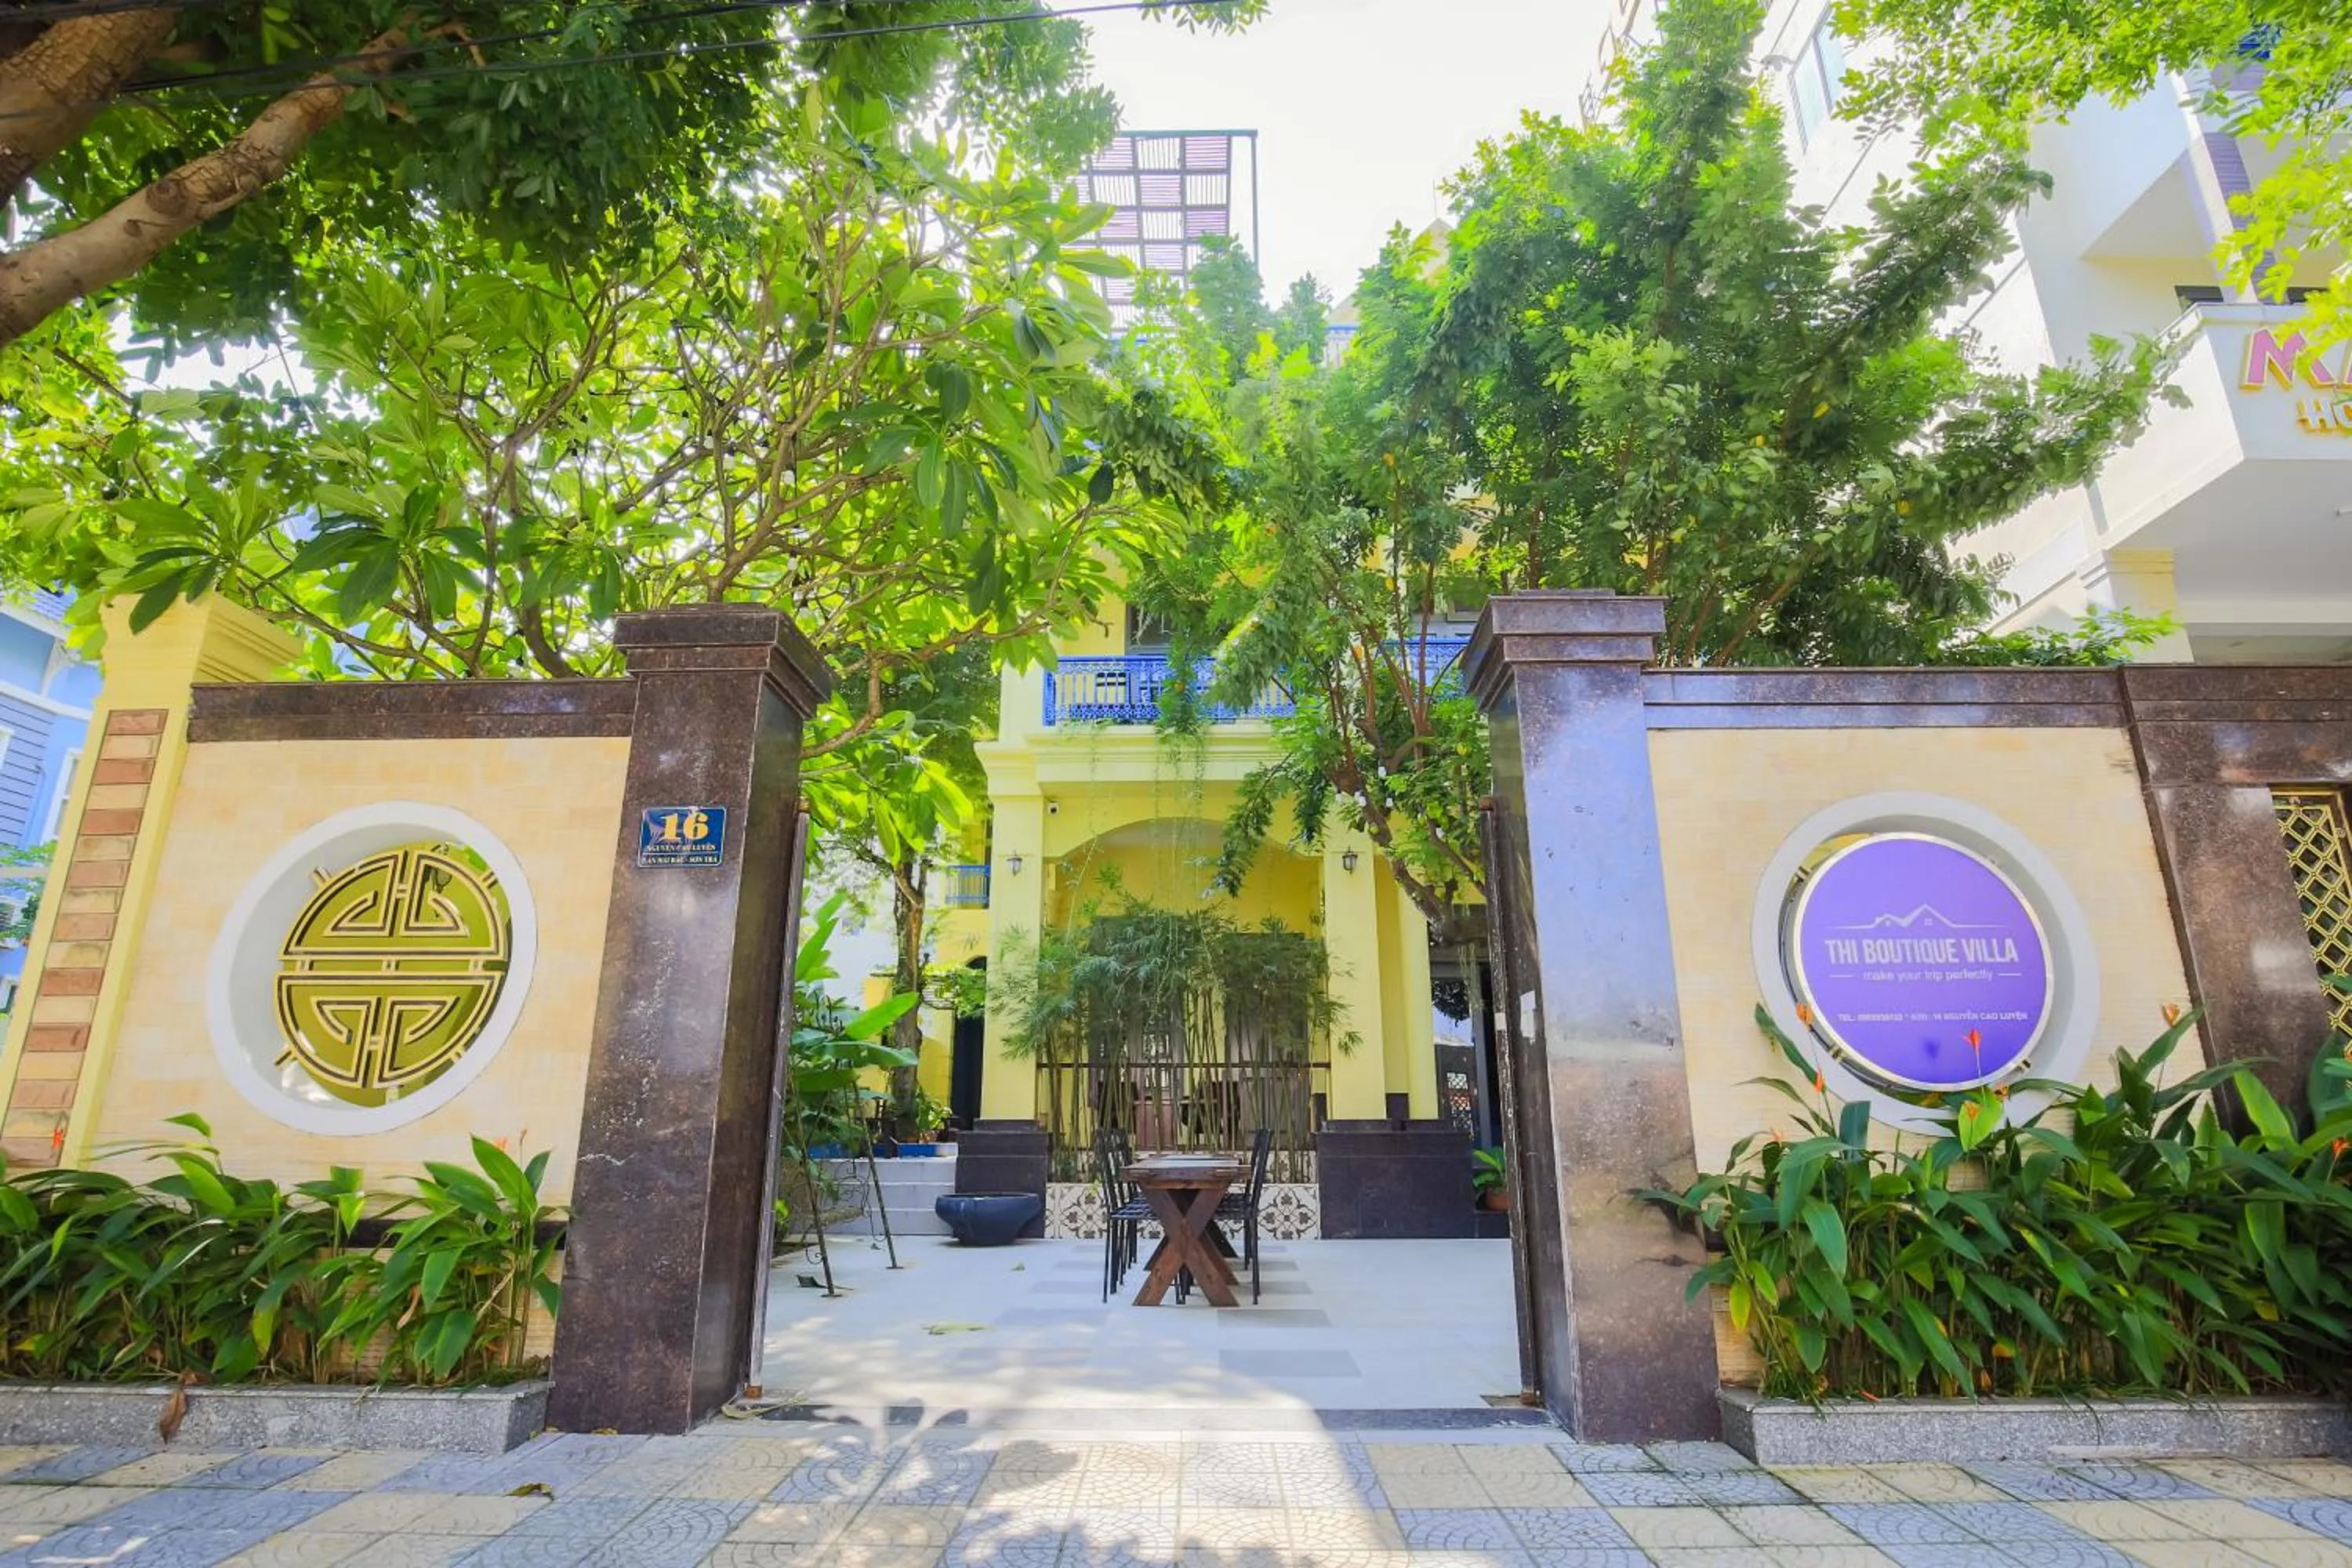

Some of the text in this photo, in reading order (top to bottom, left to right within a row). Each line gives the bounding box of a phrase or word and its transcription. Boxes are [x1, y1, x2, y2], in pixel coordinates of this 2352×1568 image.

[659, 811, 709, 841] 16
[1824, 937, 2020, 965] THI BOUTIQUE VILLA
[1863, 967, 1993, 982] make your trip perfectly
